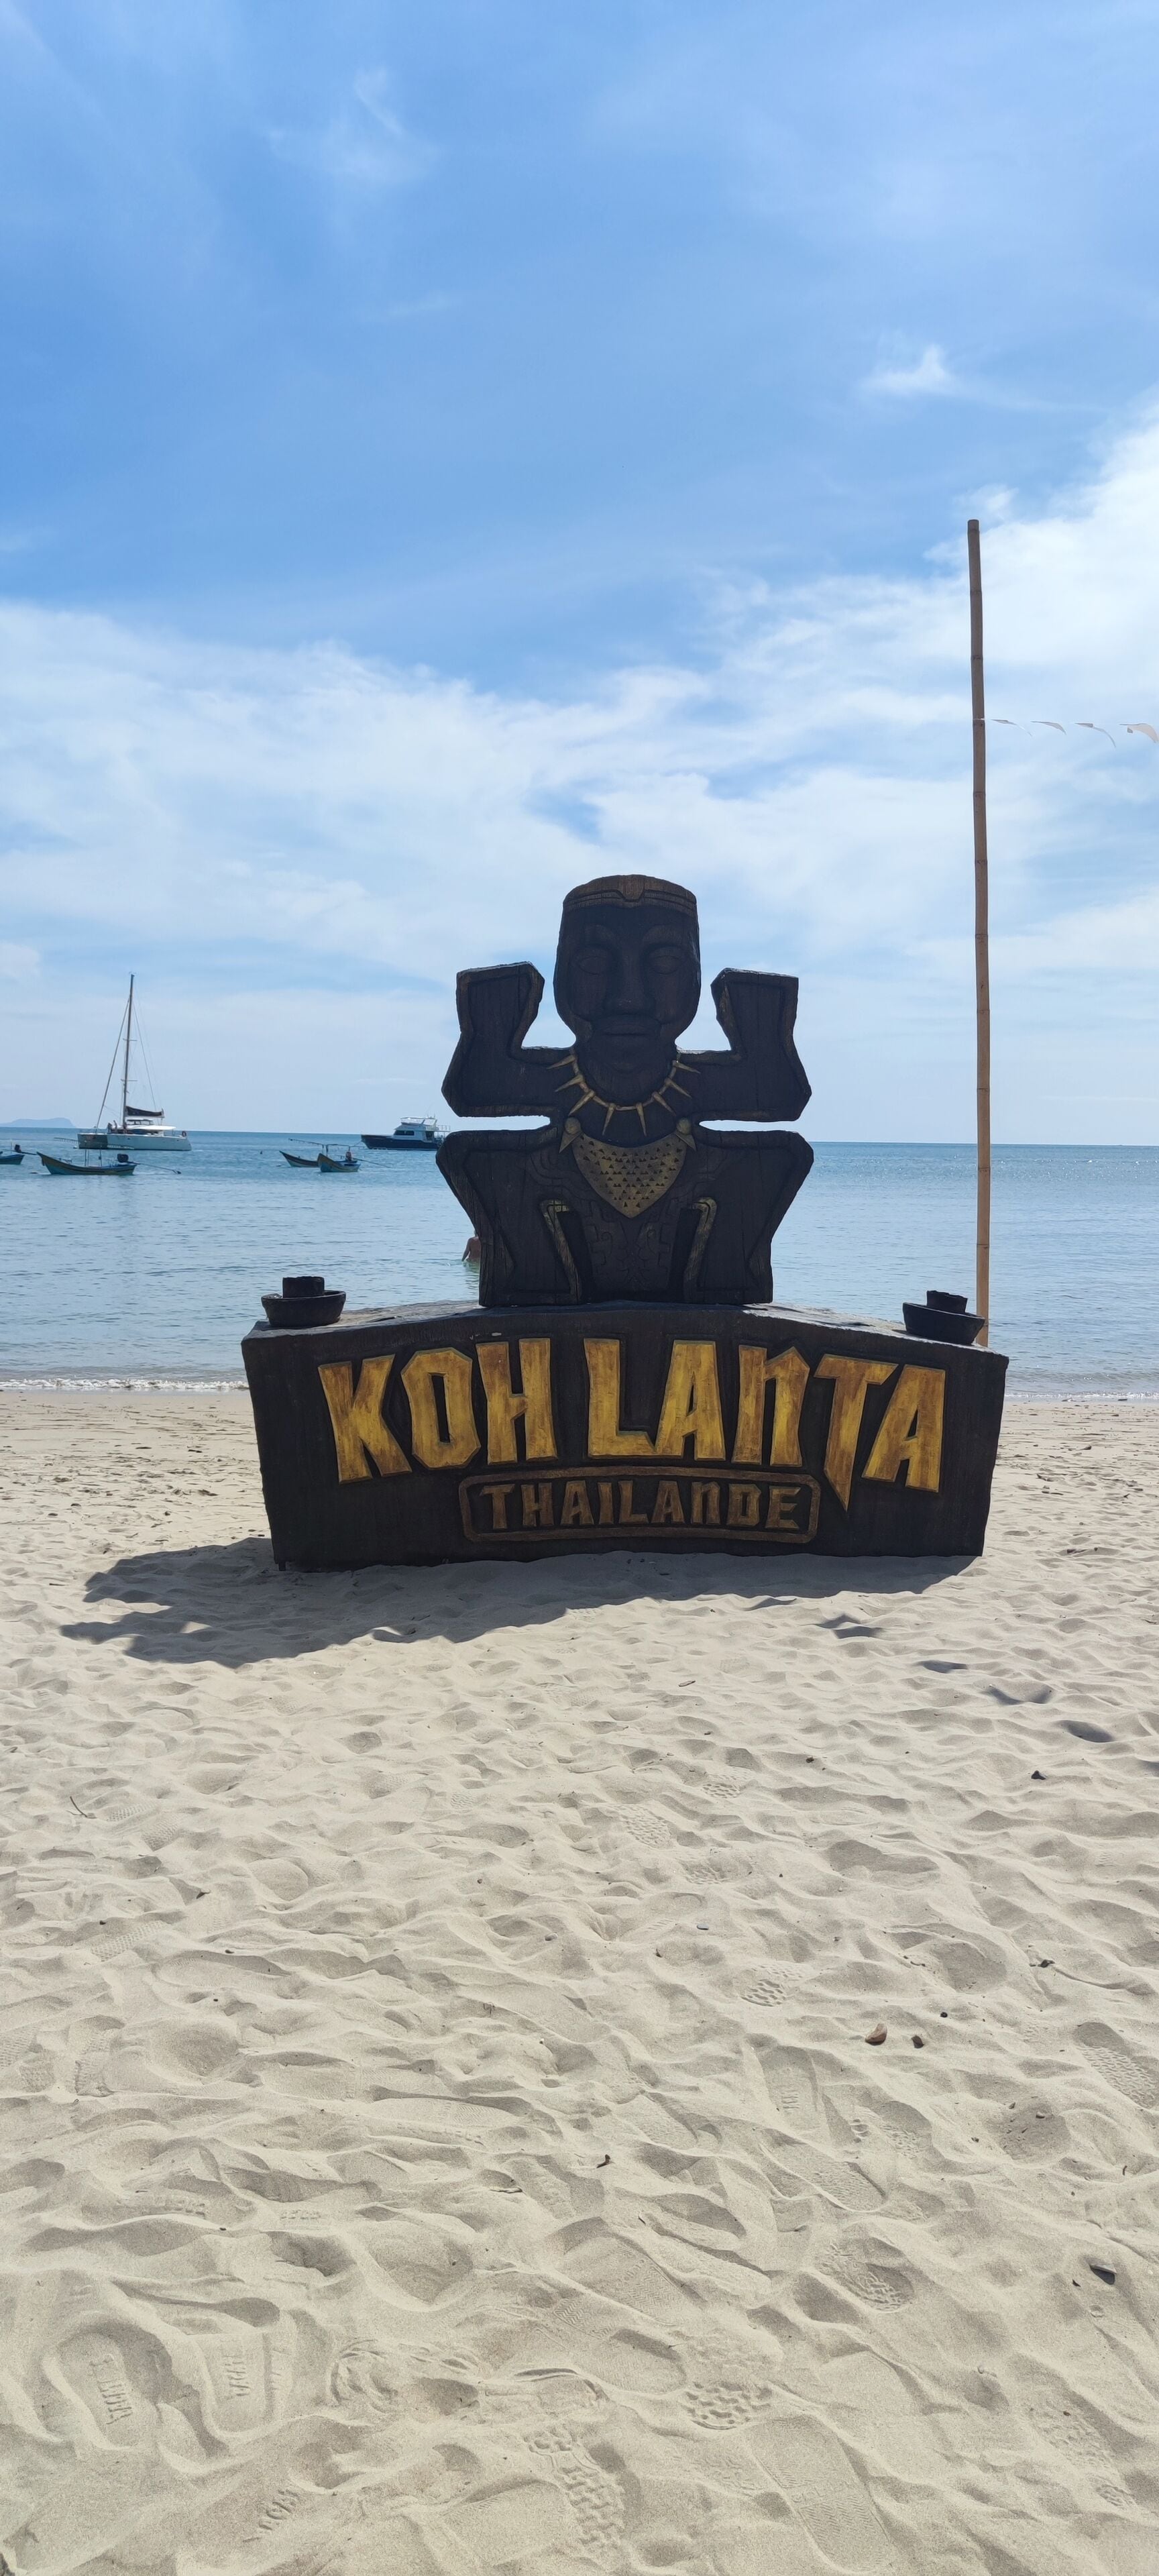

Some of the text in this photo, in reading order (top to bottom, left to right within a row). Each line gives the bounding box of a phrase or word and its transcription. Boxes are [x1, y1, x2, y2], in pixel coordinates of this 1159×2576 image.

[318, 1338, 946, 1513] KOH LANTA
[479, 1480, 801, 1530] THAILANDE
